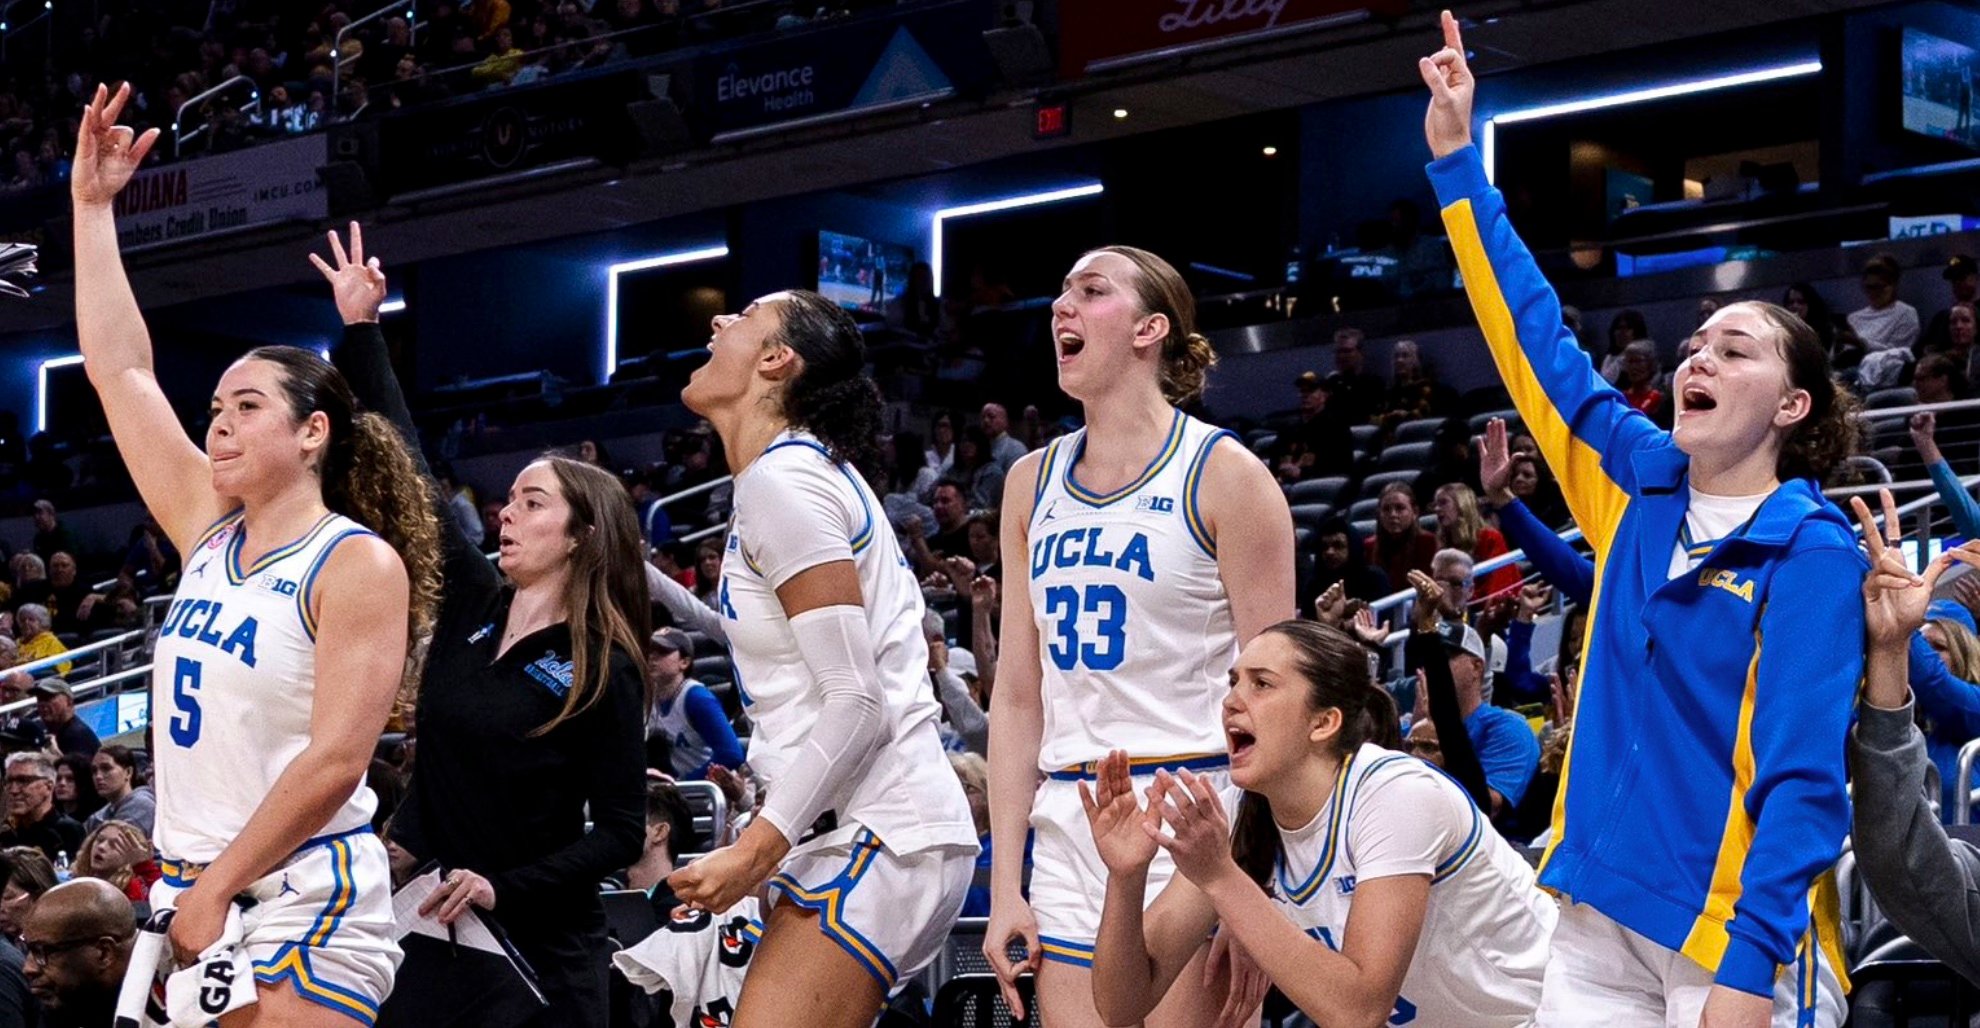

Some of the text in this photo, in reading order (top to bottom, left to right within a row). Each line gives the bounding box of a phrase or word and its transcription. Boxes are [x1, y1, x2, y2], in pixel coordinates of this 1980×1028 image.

[717, 65, 814, 102] Elevance
[763, 88, 814, 112] Health
[114, 169, 187, 218] NDIANA
[167, 210, 204, 238] Credit
[209, 206, 246, 229] Union
[1032, 527, 1155, 582] UCLA
[1698, 568, 1754, 604] UCLA
[161, 599, 258, 669] UCLA
[1045, 584, 1127, 671] 33
[169, 656, 202, 749] 5
